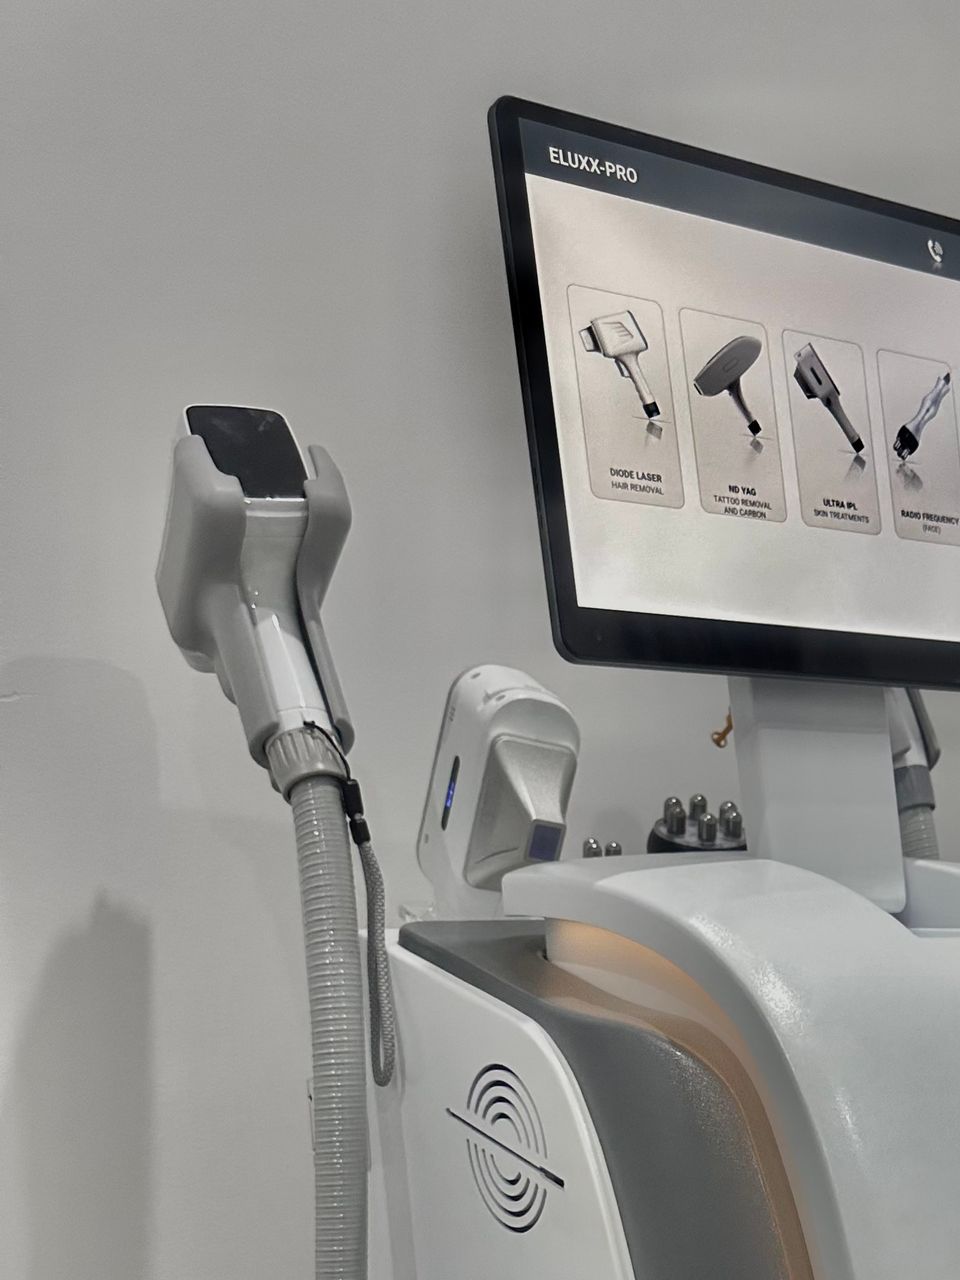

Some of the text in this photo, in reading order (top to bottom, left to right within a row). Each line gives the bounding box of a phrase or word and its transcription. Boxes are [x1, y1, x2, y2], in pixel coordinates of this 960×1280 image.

[548, 146, 638, 184] ELUXX-PRO
[609, 467, 663, 483] DIODE LASER
[611, 481, 664, 495] HAIR REMOVAL
[728, 485, 757, 496] ND YAG
[713, 495, 772, 510] TATTOO REMOVAL
[822, 498, 858, 511] ULTRA IPL
[724, 506, 767, 519] AND CARBON
[813, 508, 870, 524] SKIN TREATMENTS
[900, 509, 960, 526] RADIO FREQUENCY
[922, 524, 942, 535] (FACE)
